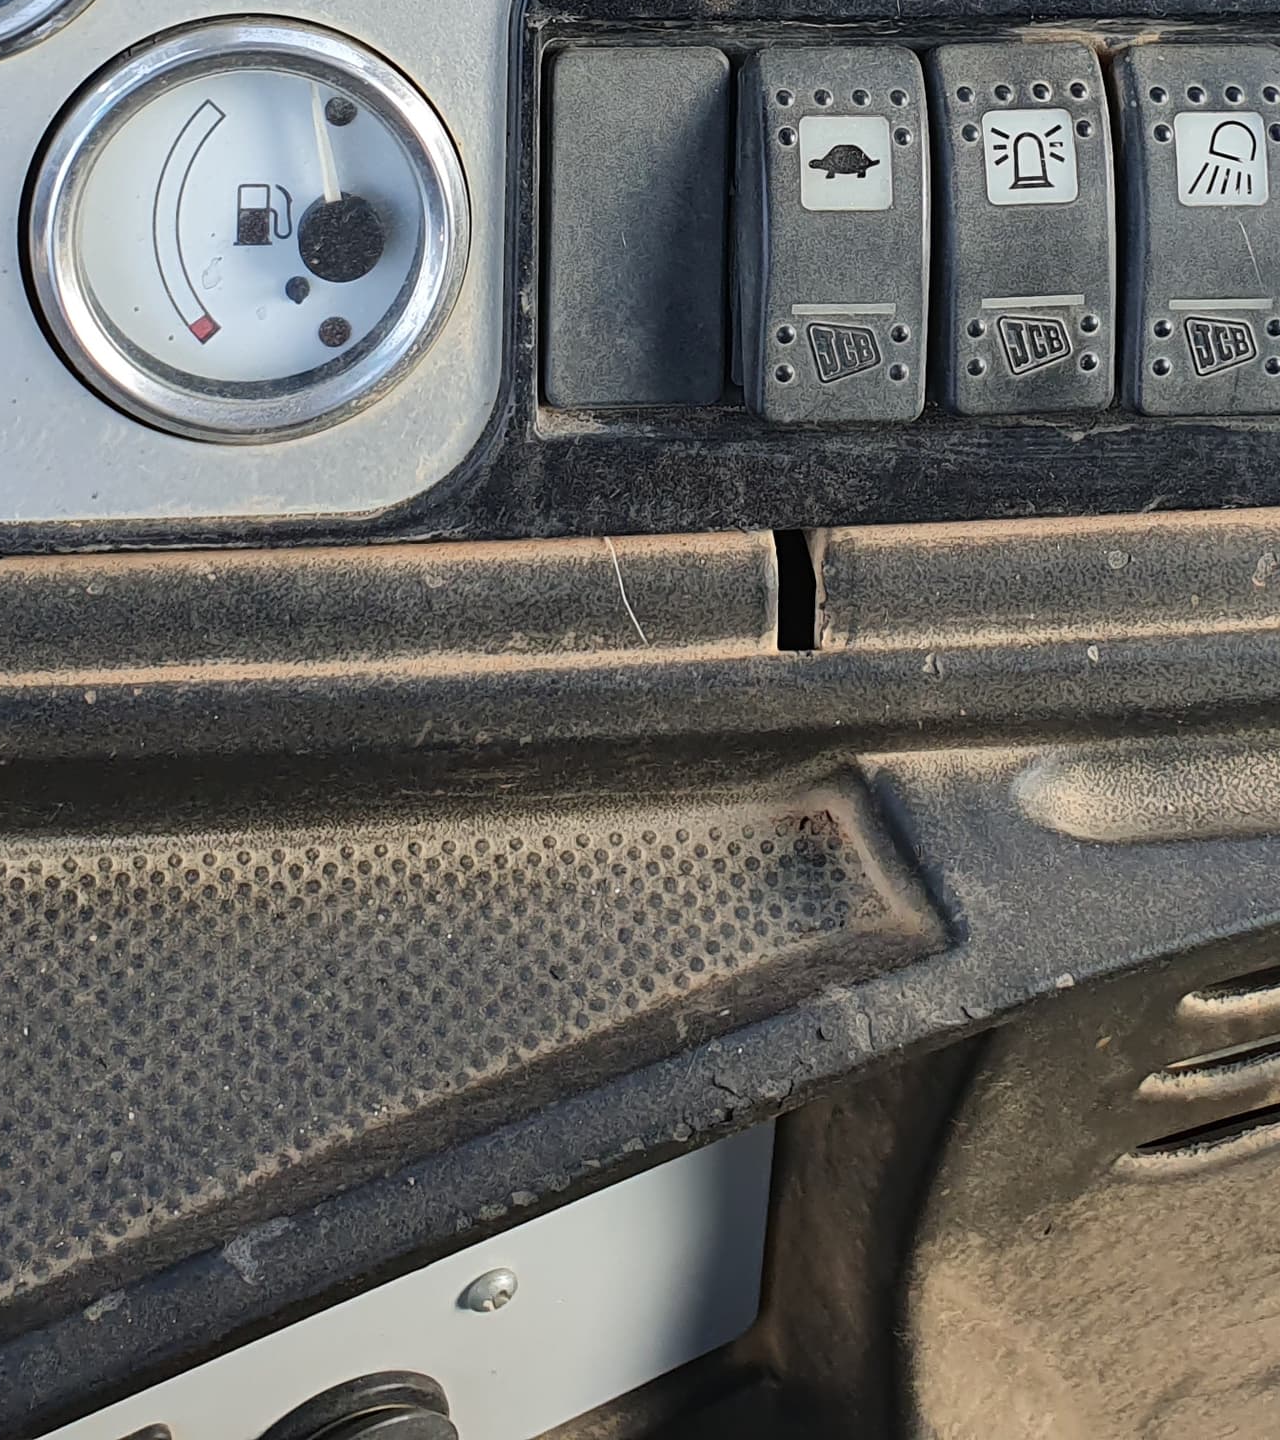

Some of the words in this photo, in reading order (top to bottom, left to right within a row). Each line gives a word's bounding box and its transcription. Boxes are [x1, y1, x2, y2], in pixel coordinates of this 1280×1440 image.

[818, 328, 874, 374] JCB
[1007, 323, 1065, 366] JCB
[1196, 322, 1251, 367] JCB
